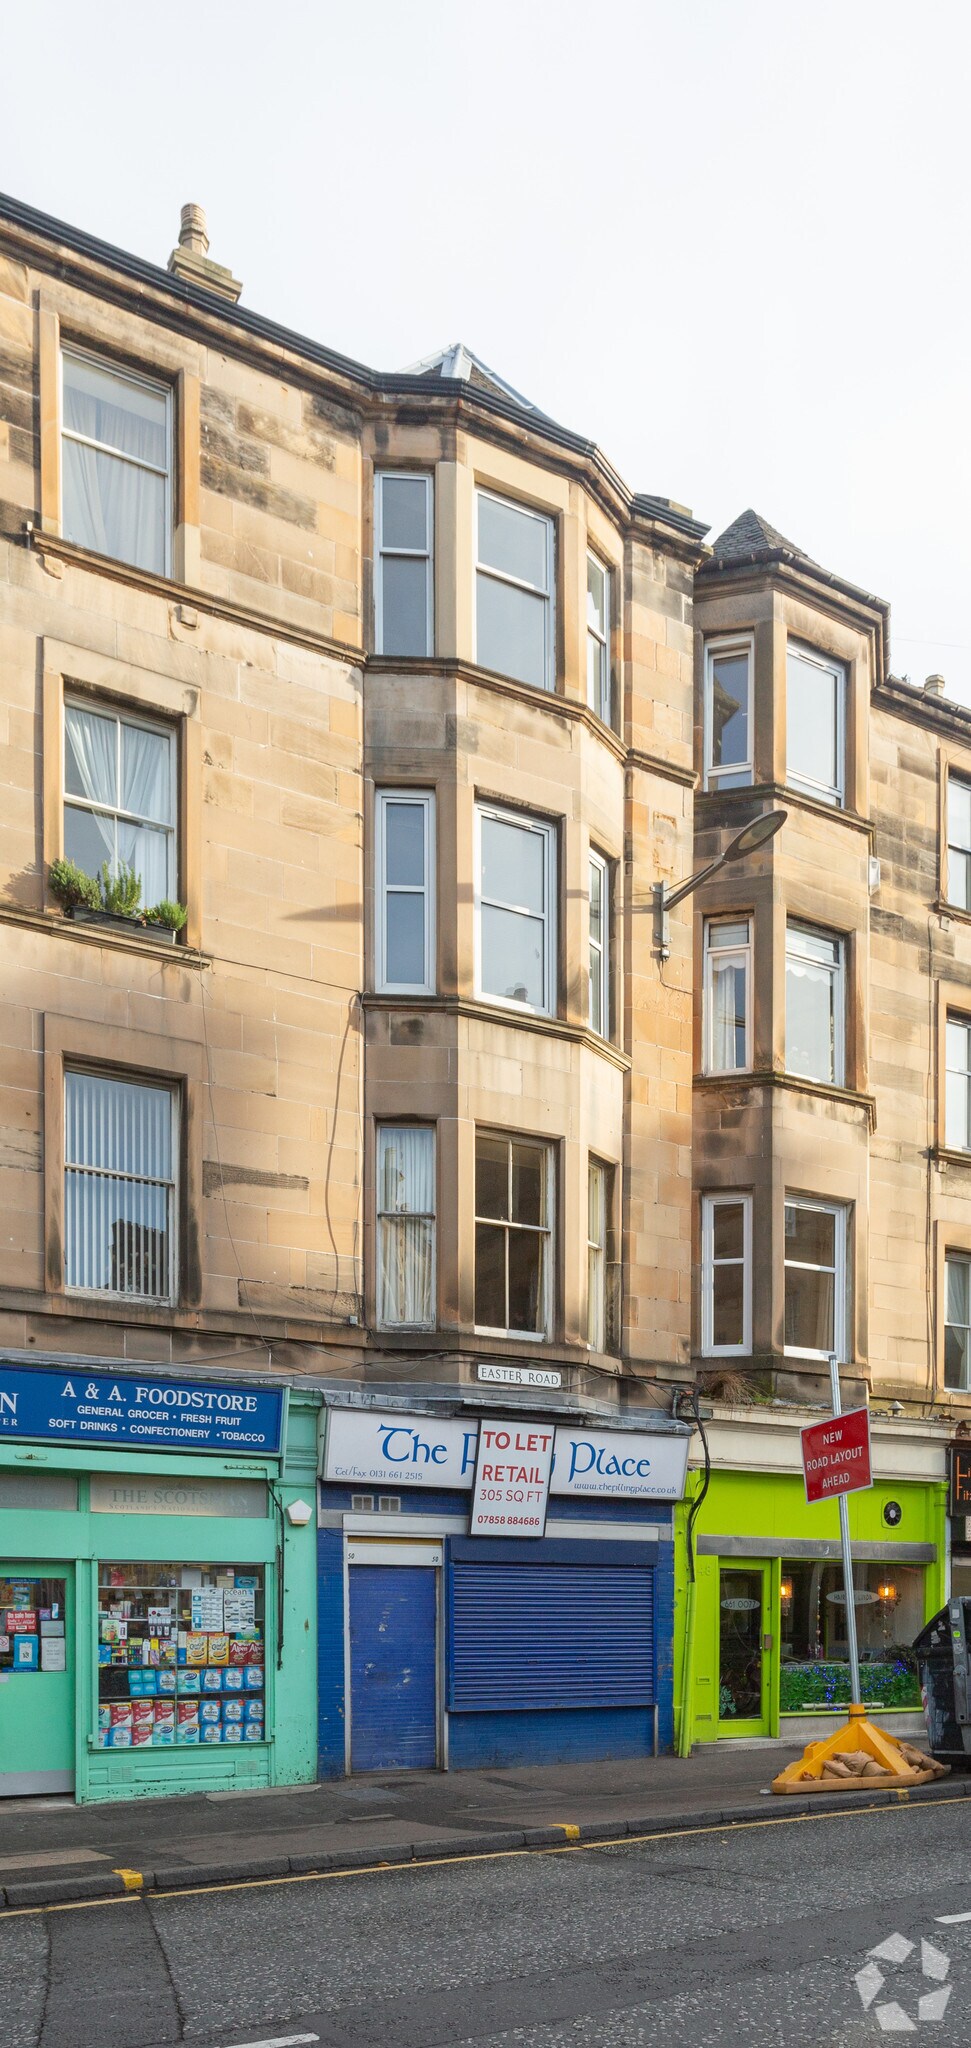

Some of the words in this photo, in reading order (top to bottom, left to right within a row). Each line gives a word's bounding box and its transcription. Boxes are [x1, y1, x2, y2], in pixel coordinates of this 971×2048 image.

[481, 1367, 522, 1381] EASTER
[528, 1372, 559, 1385] ROAD
[60, 1381, 77, 1398] A
[85, 1382, 99, 1400] &
[135, 1387, 258, 1412] FOODSTORE
[77, 1405, 124, 1417] GENERAL
[128, 1409, 169, 1421] GROCER
[181, 1413, 212, 1424] FRESH
[215, 1416, 241, 1426] FRUIT
[48, 1418, 76, 1429] SOFT
[80, 1421, 118, 1432] DRINKS
[129, 1425, 210, 1439] CONFECTIONERY
[221, 1431, 265, 1443] TOBACCO
[822, 1430, 843, 1445] NEW
[377, 1423, 448, 1464] The
[483, 1431, 511, 1449] TO
[515, 1433, 552, 1452] LET
[568, 1441, 652, 1483] Place
[806, 1456, 828, 1471] ROAD
[830, 1446, 863, 1465] LAYOUT
[369, 1470, 386, 1478] 0131
[388, 1470, 402, 1479] 661
[405, 1472, 423, 1480] 2515
[482, 1464, 544, 1484] RETAIL
[822, 1472, 850, 1489] AHEAD
[110, 1488, 148, 1503] THE
[479, 1489, 503, 1501] 305
[506, 1489, 524, 1503] SQ
[527, 1491, 543, 1503] FT
[477, 1515, 506, 1524] 07858
[507, 1516, 540, 1526] 884686
